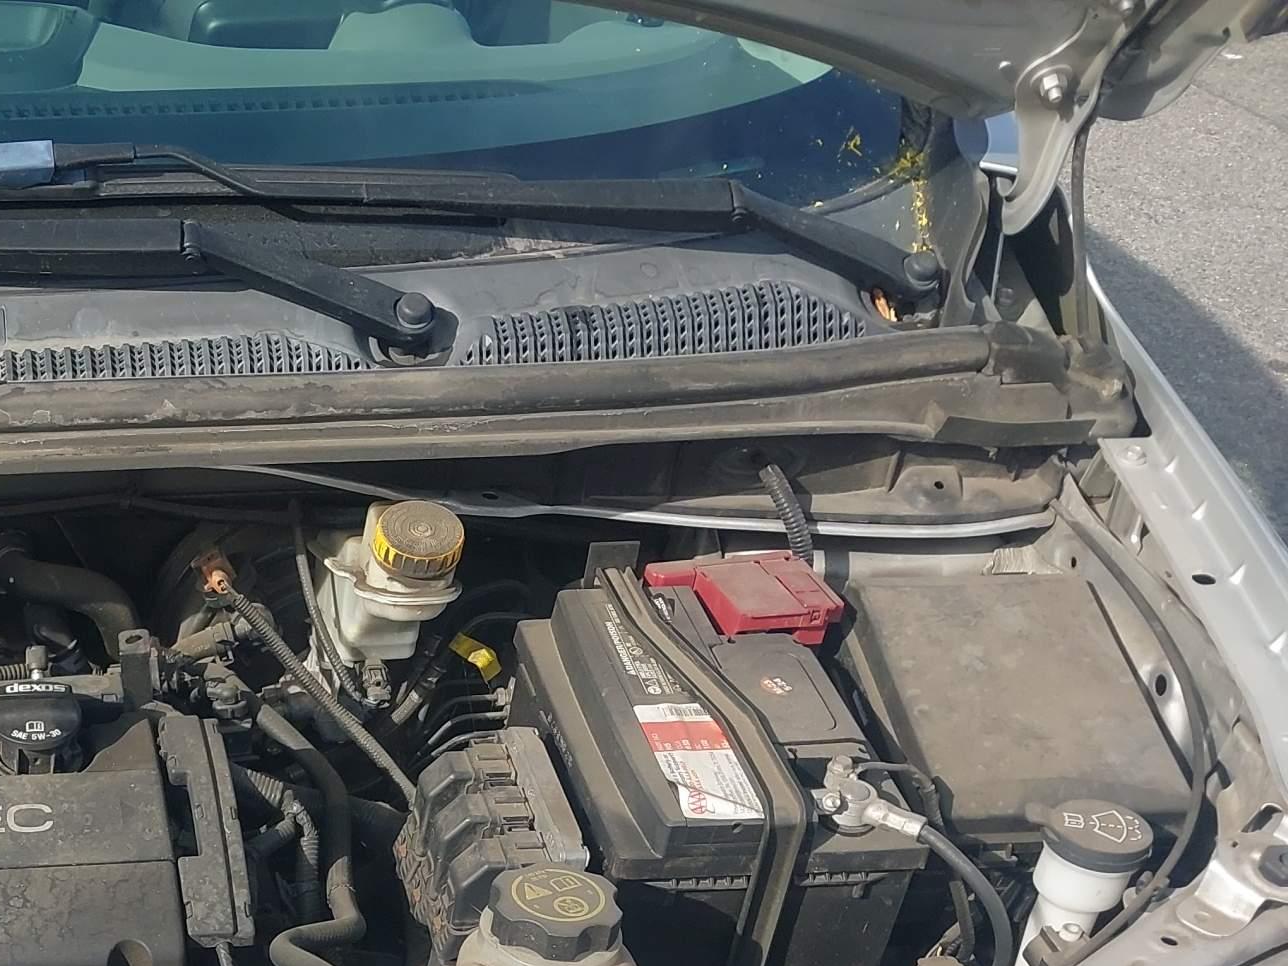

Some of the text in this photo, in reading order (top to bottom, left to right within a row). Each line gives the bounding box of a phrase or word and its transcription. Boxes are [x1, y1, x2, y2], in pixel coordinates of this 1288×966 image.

[5, 683, 66, 693] dexos
[11, 728, 62, 741] SAE 5W-30
